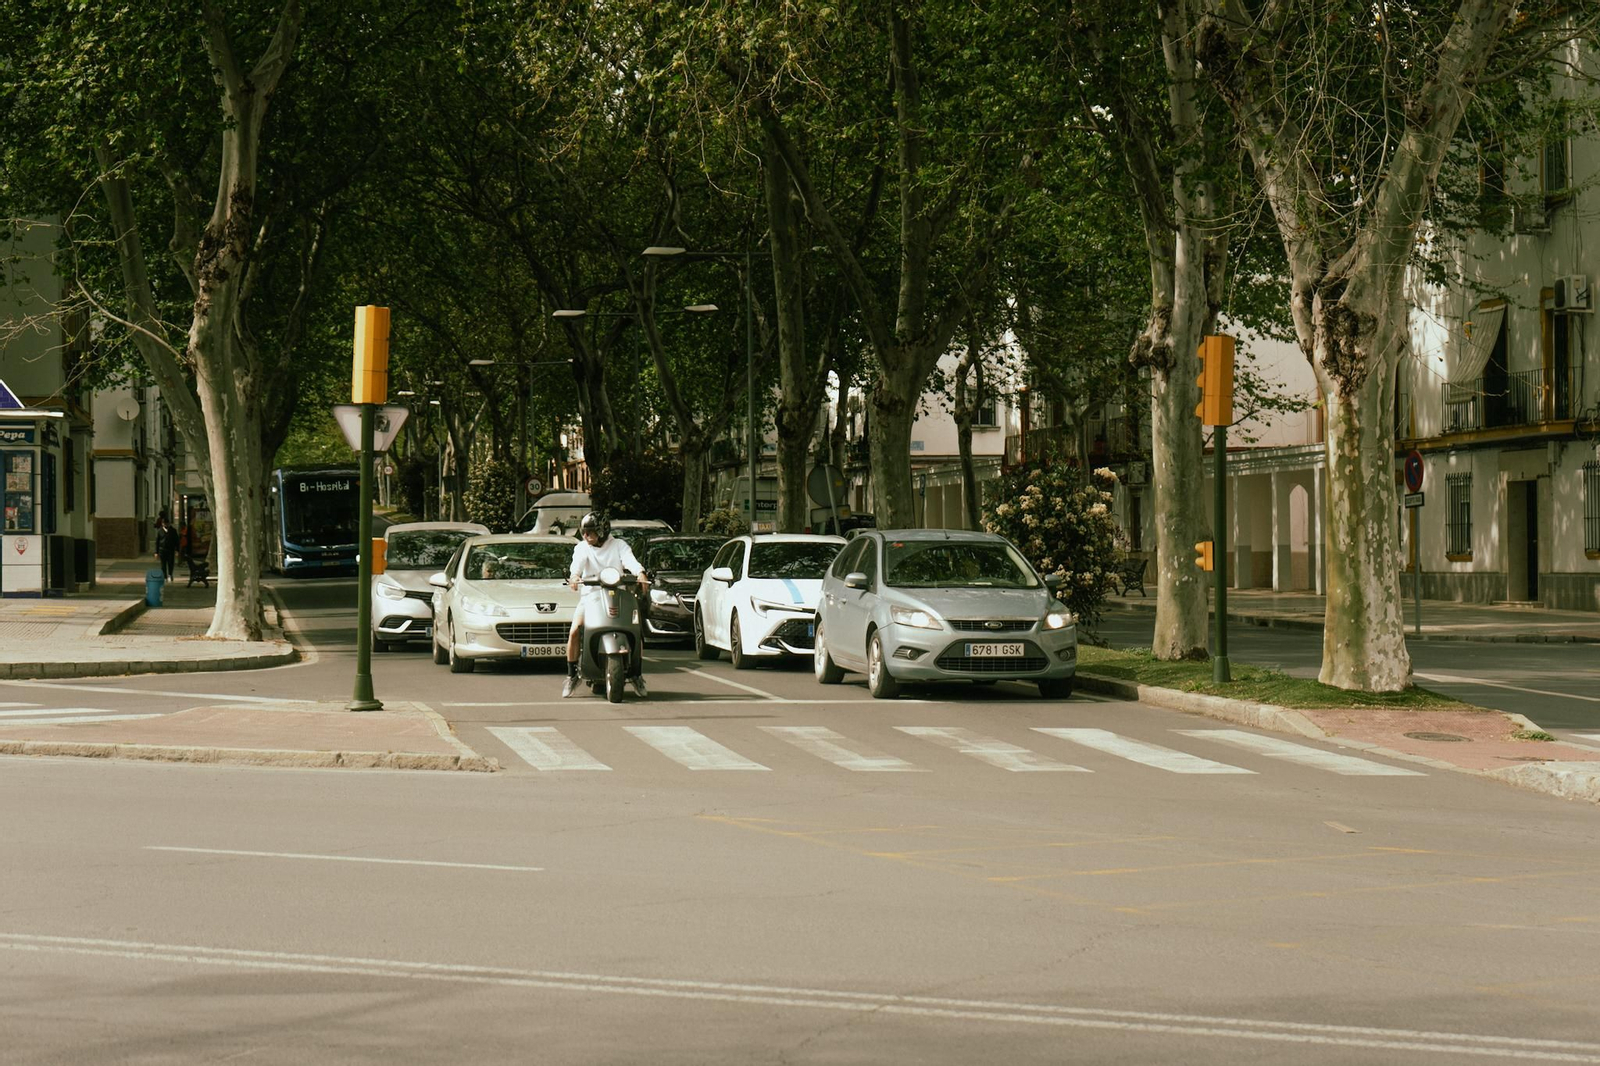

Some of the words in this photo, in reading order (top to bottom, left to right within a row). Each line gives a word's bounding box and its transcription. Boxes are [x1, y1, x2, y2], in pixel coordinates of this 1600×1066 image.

[316, 480, 350, 491] Hospital
[528, 646, 552, 656] 9098
[972, 645, 998, 655] 6781
[1002, 645, 1021, 655] GSK
